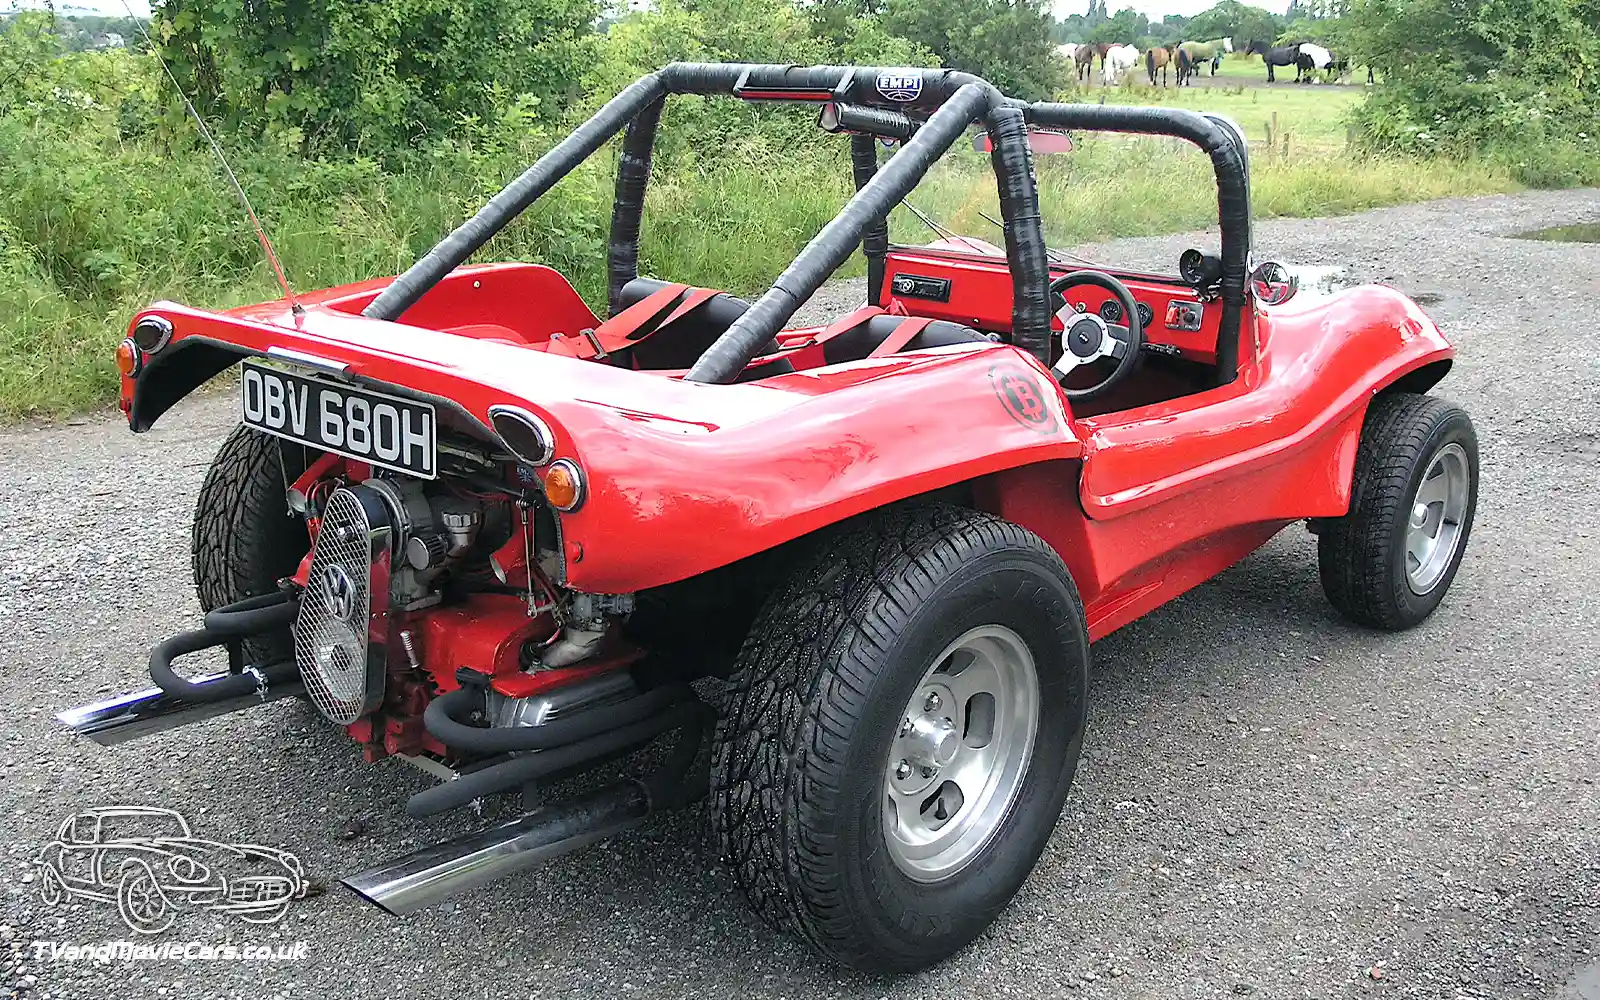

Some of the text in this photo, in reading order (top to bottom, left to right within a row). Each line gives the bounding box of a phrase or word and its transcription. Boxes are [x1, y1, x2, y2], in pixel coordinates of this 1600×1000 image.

[880, 77, 919, 89] EMPI
[244, 369, 430, 471] OBV 680H
